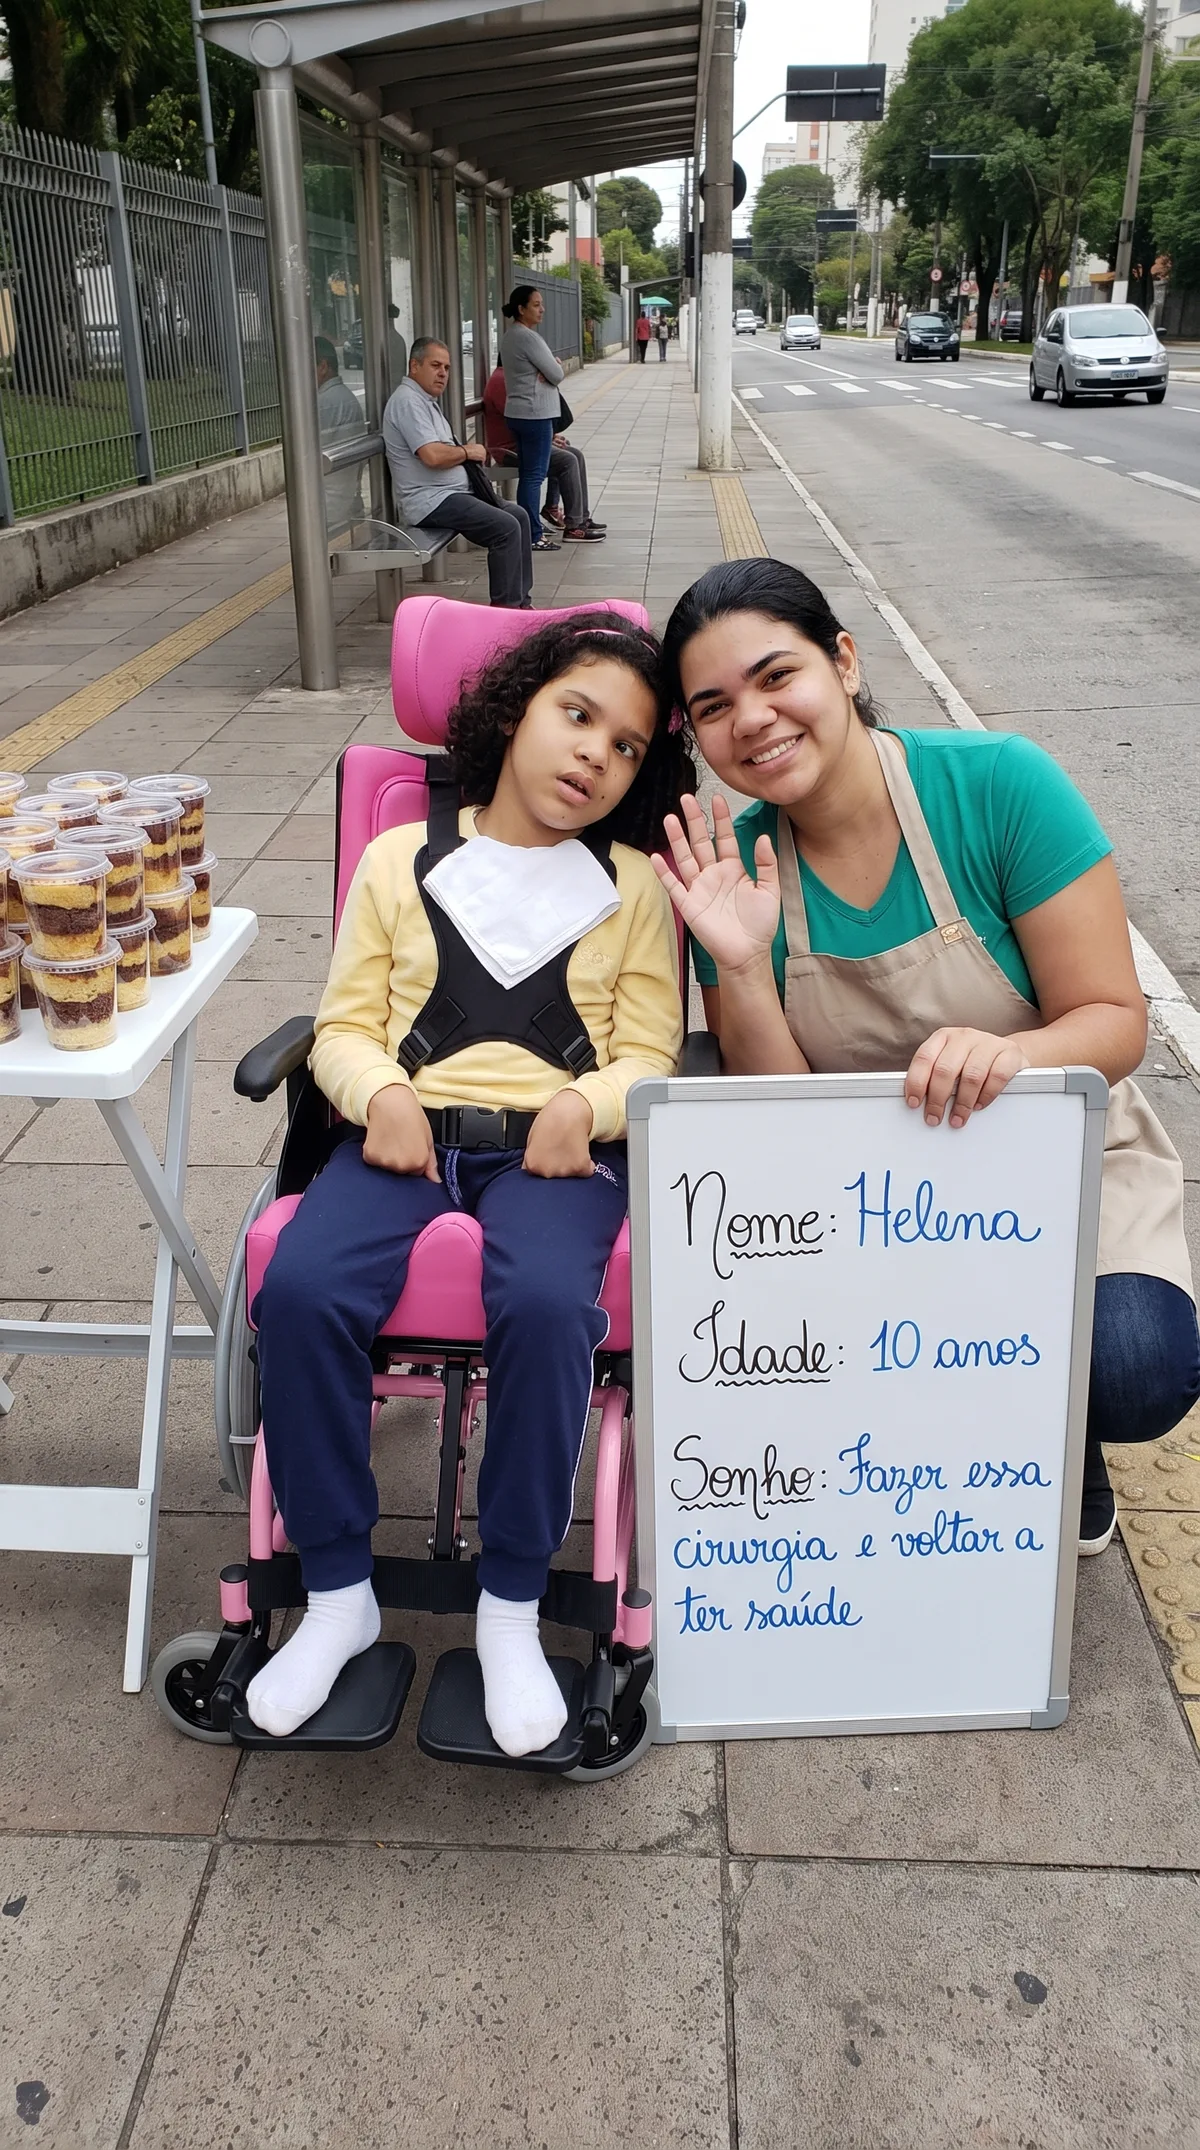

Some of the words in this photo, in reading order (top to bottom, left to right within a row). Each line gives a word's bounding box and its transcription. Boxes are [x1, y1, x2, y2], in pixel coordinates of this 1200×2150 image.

[669, 1170, 838, 1280] Nome:
[843, 1169, 1042, 1248] Helena
[678, 1299, 845, 1383] Idade:
[868, 1319, 922, 1373] 10
[932, 1333, 1041, 1370] anos
[670, 1434, 828, 1521] Sonho:
[838, 1432, 949, 1516] Fazer
[961, 1461, 1053, 1489] essa
[673, 1528, 838, 1594] cirurgia
[854, 1534, 877, 1558] e
[891, 1508, 1004, 1558] voltar
[1014, 1526, 1045, 1553] a
[674, 1585, 733, 1636] ter
[743, 1584, 863, 1632] saúde
